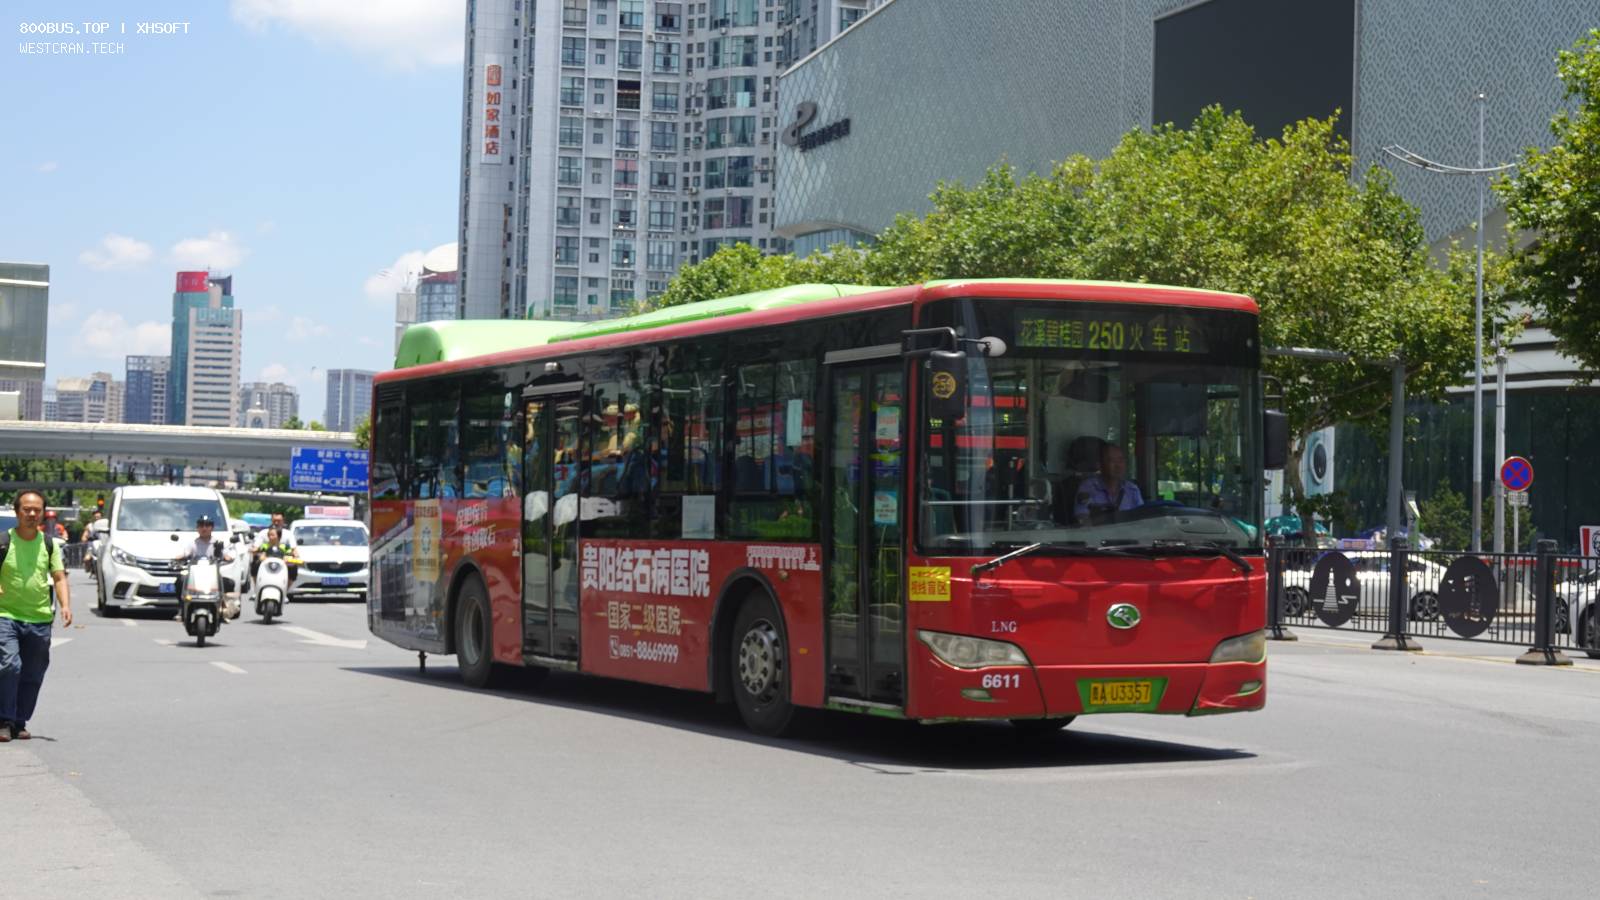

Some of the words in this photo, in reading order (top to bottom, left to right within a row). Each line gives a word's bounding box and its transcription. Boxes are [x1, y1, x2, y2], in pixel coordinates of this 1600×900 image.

[485, 91, 501, 155] 如家酒店
[1089, 321, 1125, 350] 250
[1129, 324, 1191, 352] 火车站
[582, 543, 710, 597] 贵阳结石病医院
[607, 600, 682, 636] 国家二级医院
[991, 620, 1018, 633] LNG
[619, 640, 679, 664] 0851-88669999
[981, 673, 1021, 689] 6611
